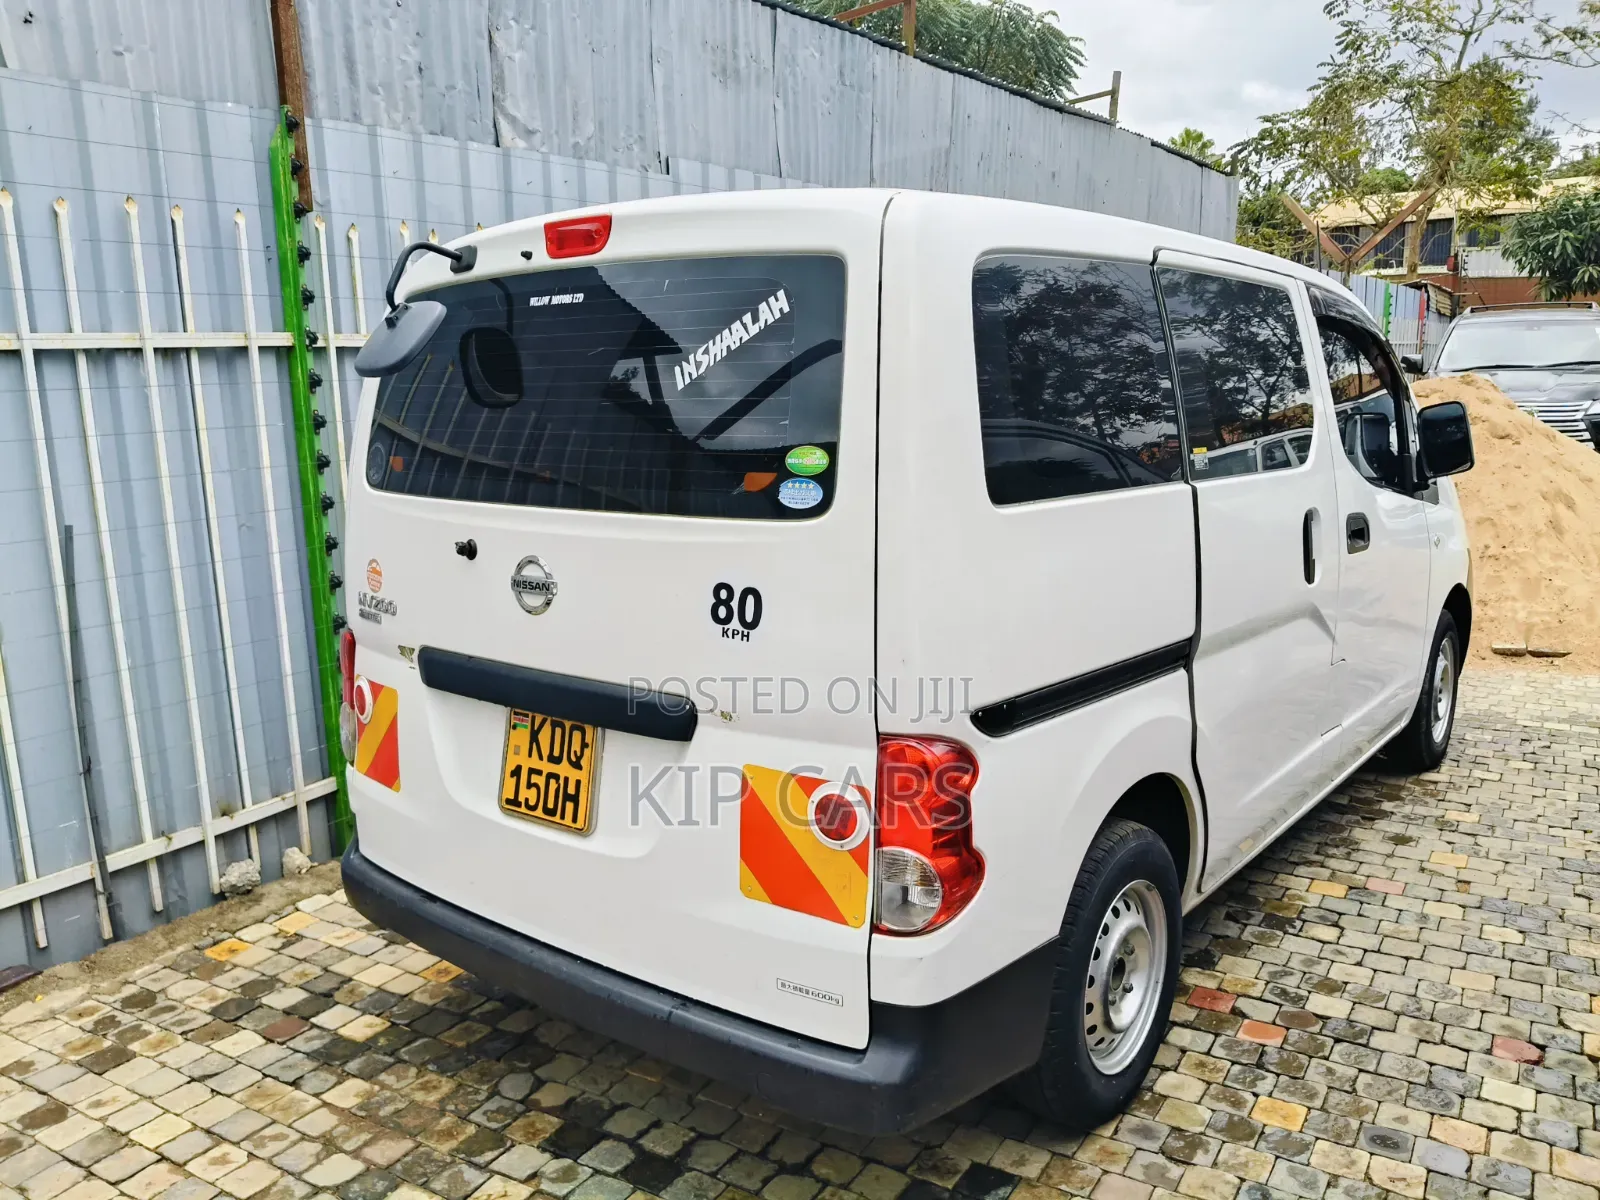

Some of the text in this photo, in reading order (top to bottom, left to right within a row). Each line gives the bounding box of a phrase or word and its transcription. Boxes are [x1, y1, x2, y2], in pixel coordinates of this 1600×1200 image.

[529, 293, 584, 307] WILLOW MOTORS LTD
[513, 579, 550, 592] NISSAN
[711, 582, 763, 631] 80
[721, 626, 750, 643] KPH
[528, 714, 590, 771] KDQ
[505, 764, 582, 824] 150H
